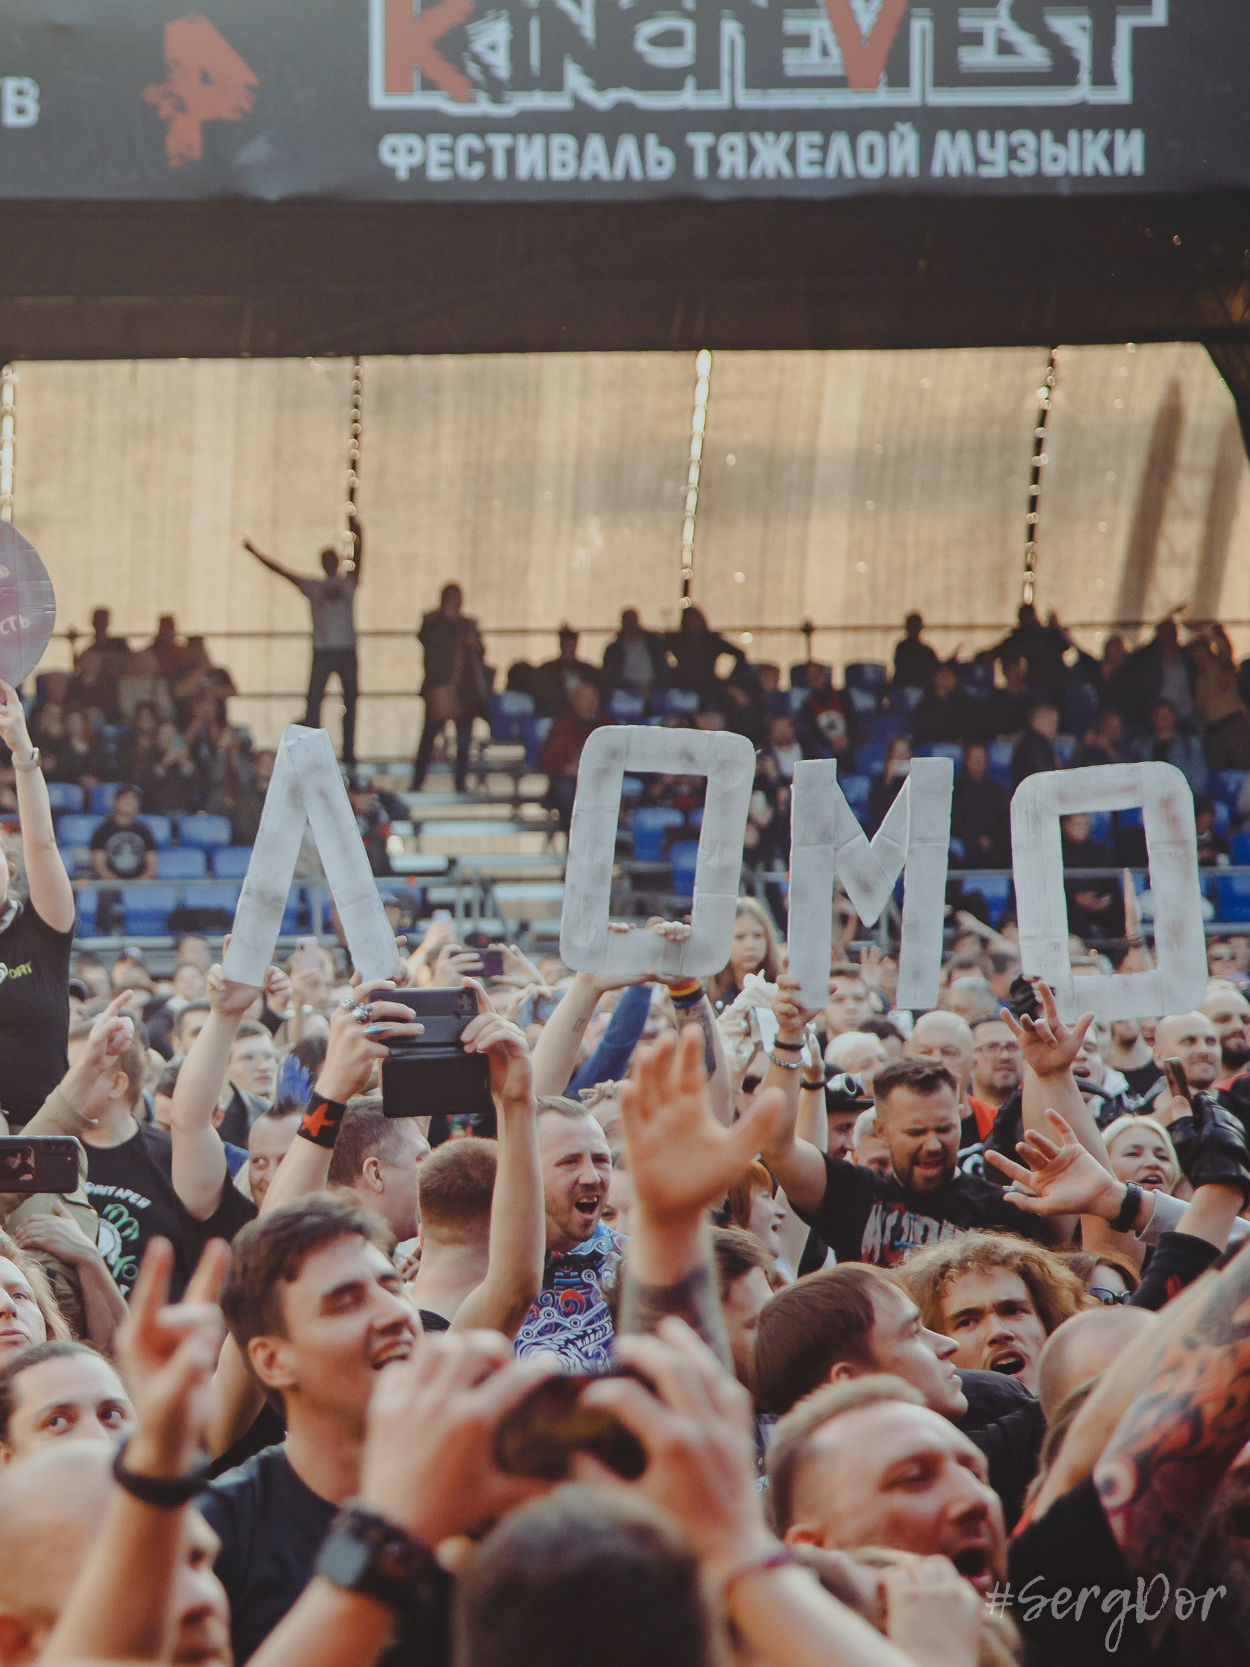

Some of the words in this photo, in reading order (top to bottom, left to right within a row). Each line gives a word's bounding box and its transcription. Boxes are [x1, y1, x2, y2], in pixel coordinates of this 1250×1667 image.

[378, 130, 676, 182] ФЕСТИВАЛЬ
[686, 122, 921, 179] ТЯЖЕЛОЙ
[932, 128, 1146, 177] МУЗЫКИ
